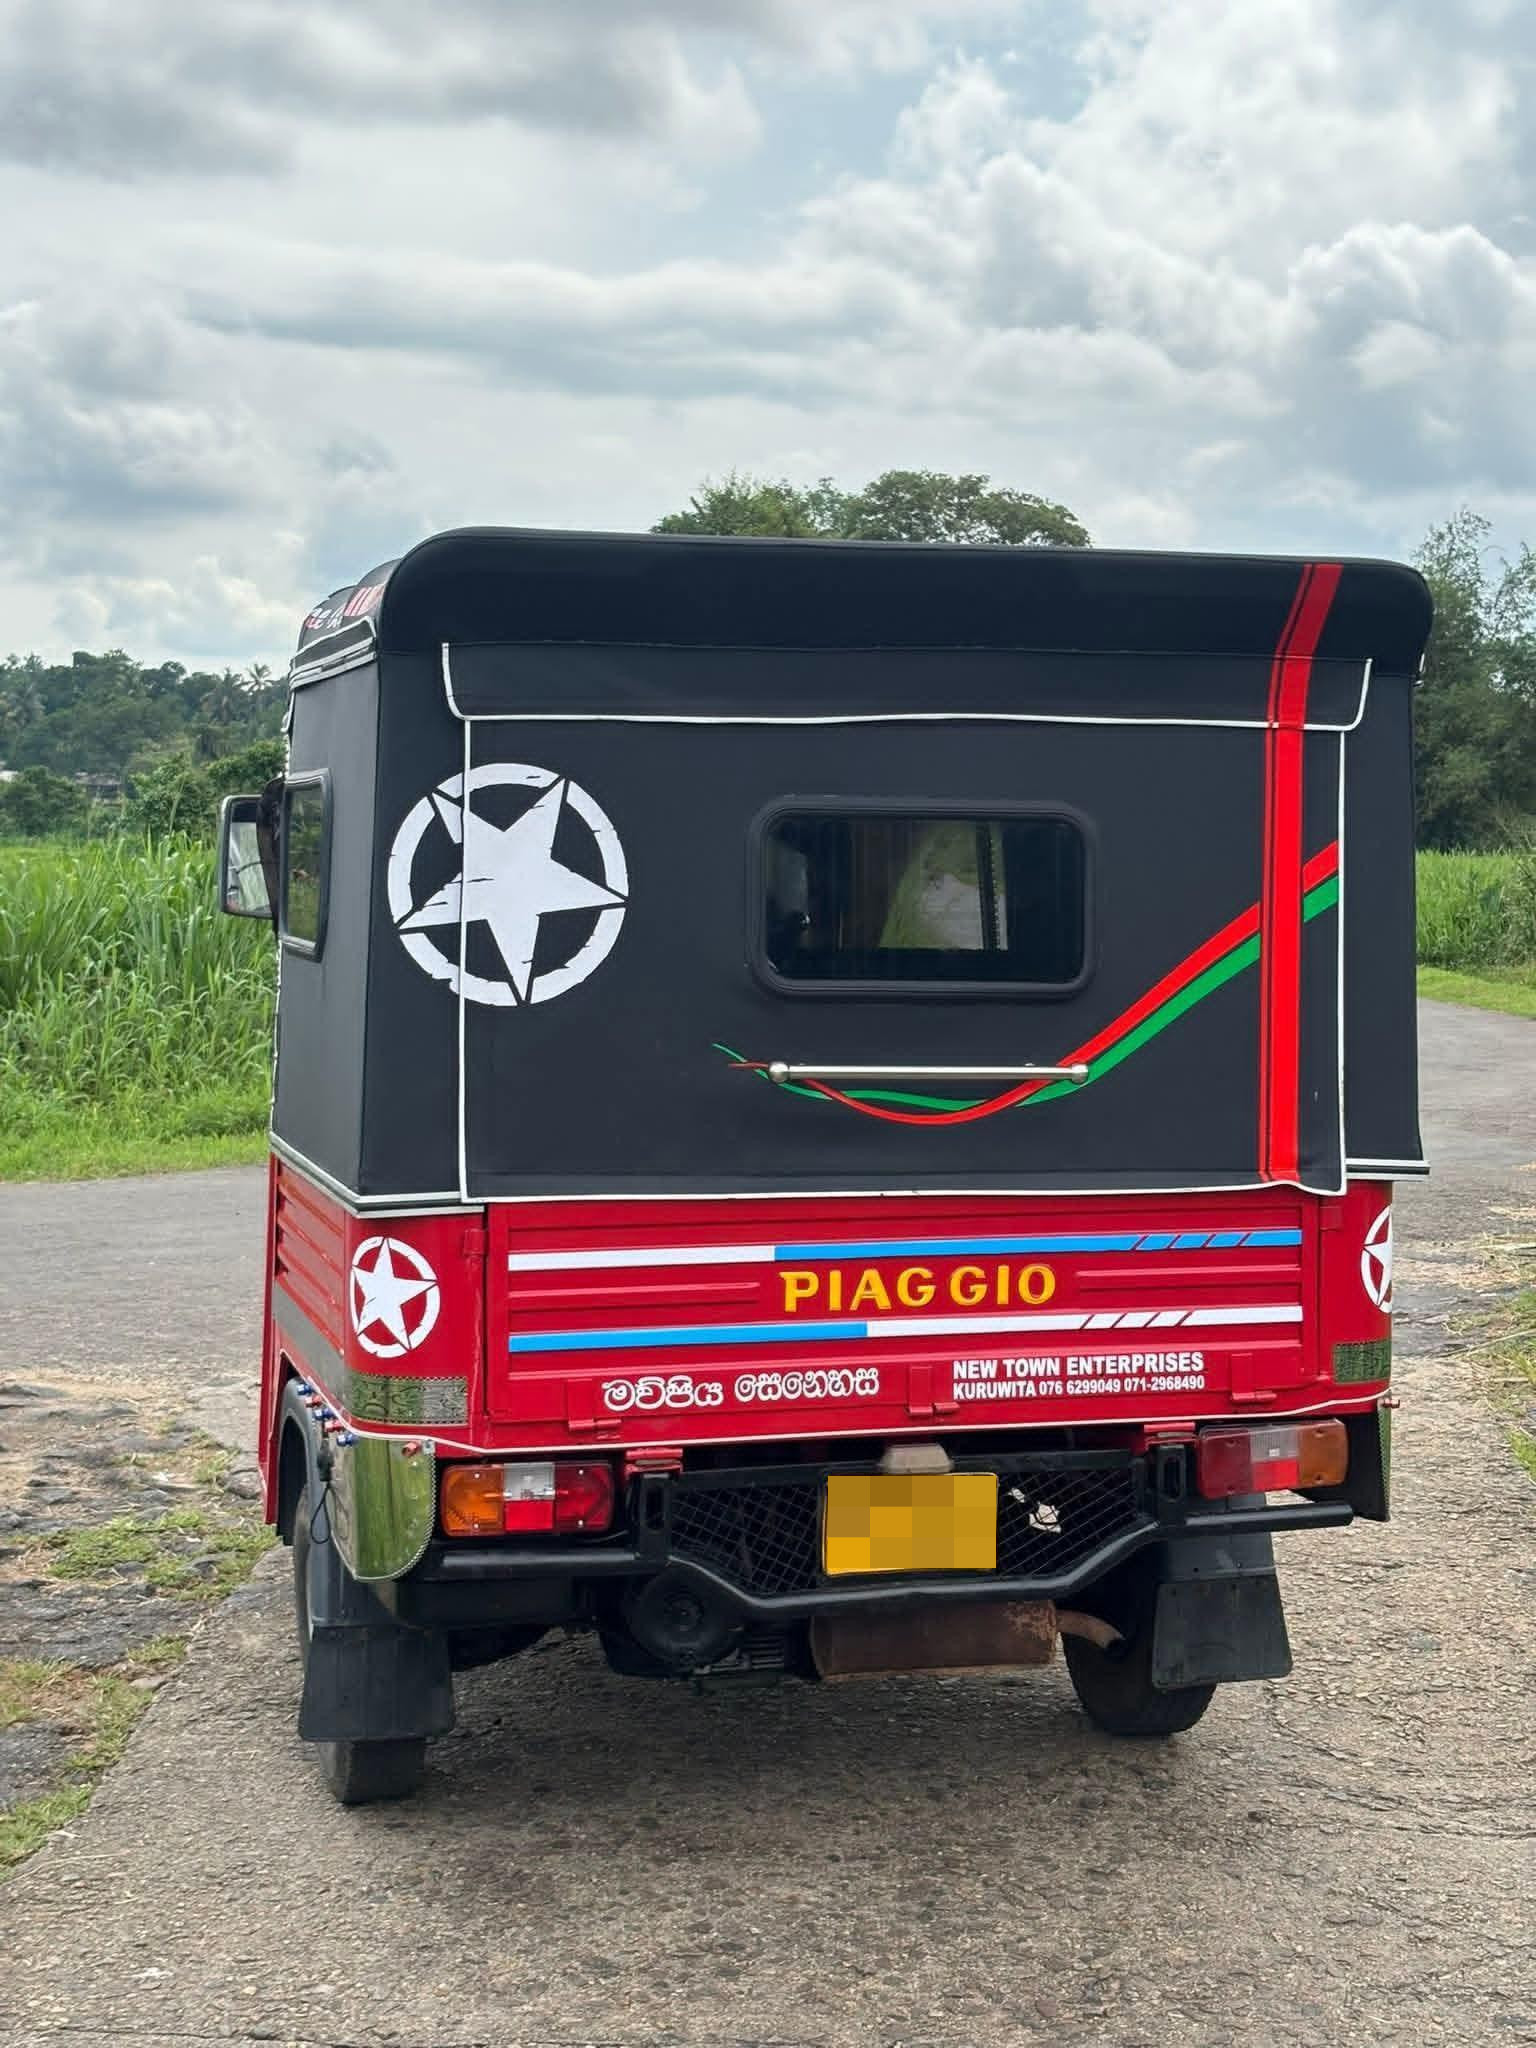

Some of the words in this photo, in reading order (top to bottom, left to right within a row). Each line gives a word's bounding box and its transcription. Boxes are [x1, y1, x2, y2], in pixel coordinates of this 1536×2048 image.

[779, 1264, 1056, 1313] PIAGGIO
[953, 1360, 998, 1379] NEW
[1003, 1358, 1060, 1377] TOWN
[1067, 1352, 1204, 1376] ENTERPRISES
[735, 1368, 879, 1402] සෙනෙහස
[953, 1380, 1036, 1400] KURUWITA
[1039, 1381, 1063, 1395] 076
[1066, 1378, 1121, 1395] 6299049
[1124, 1375, 1205, 1392] 071-2968490
